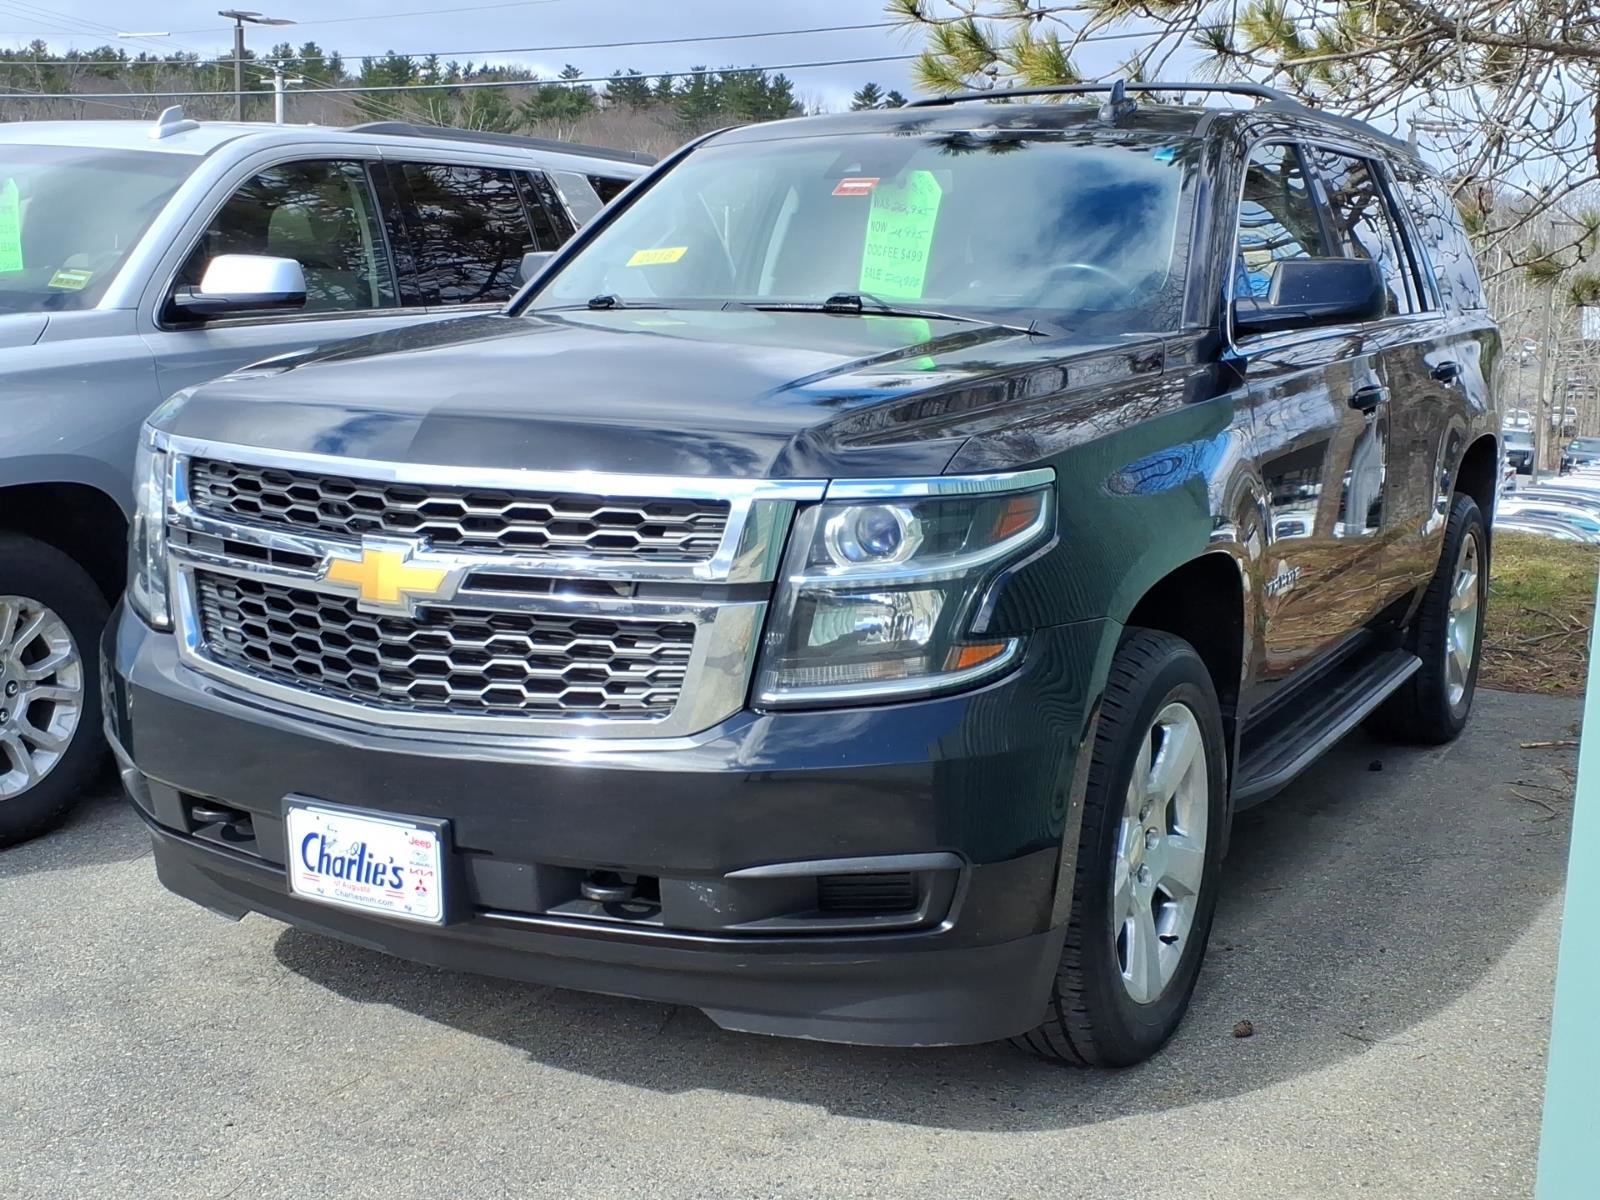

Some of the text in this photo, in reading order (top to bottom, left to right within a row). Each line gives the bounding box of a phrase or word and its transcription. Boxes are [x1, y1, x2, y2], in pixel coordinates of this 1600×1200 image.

[871, 221, 888, 233] NOW
[408, 837, 432, 849] Jeep
[301, 832, 405, 889] Charlie's
